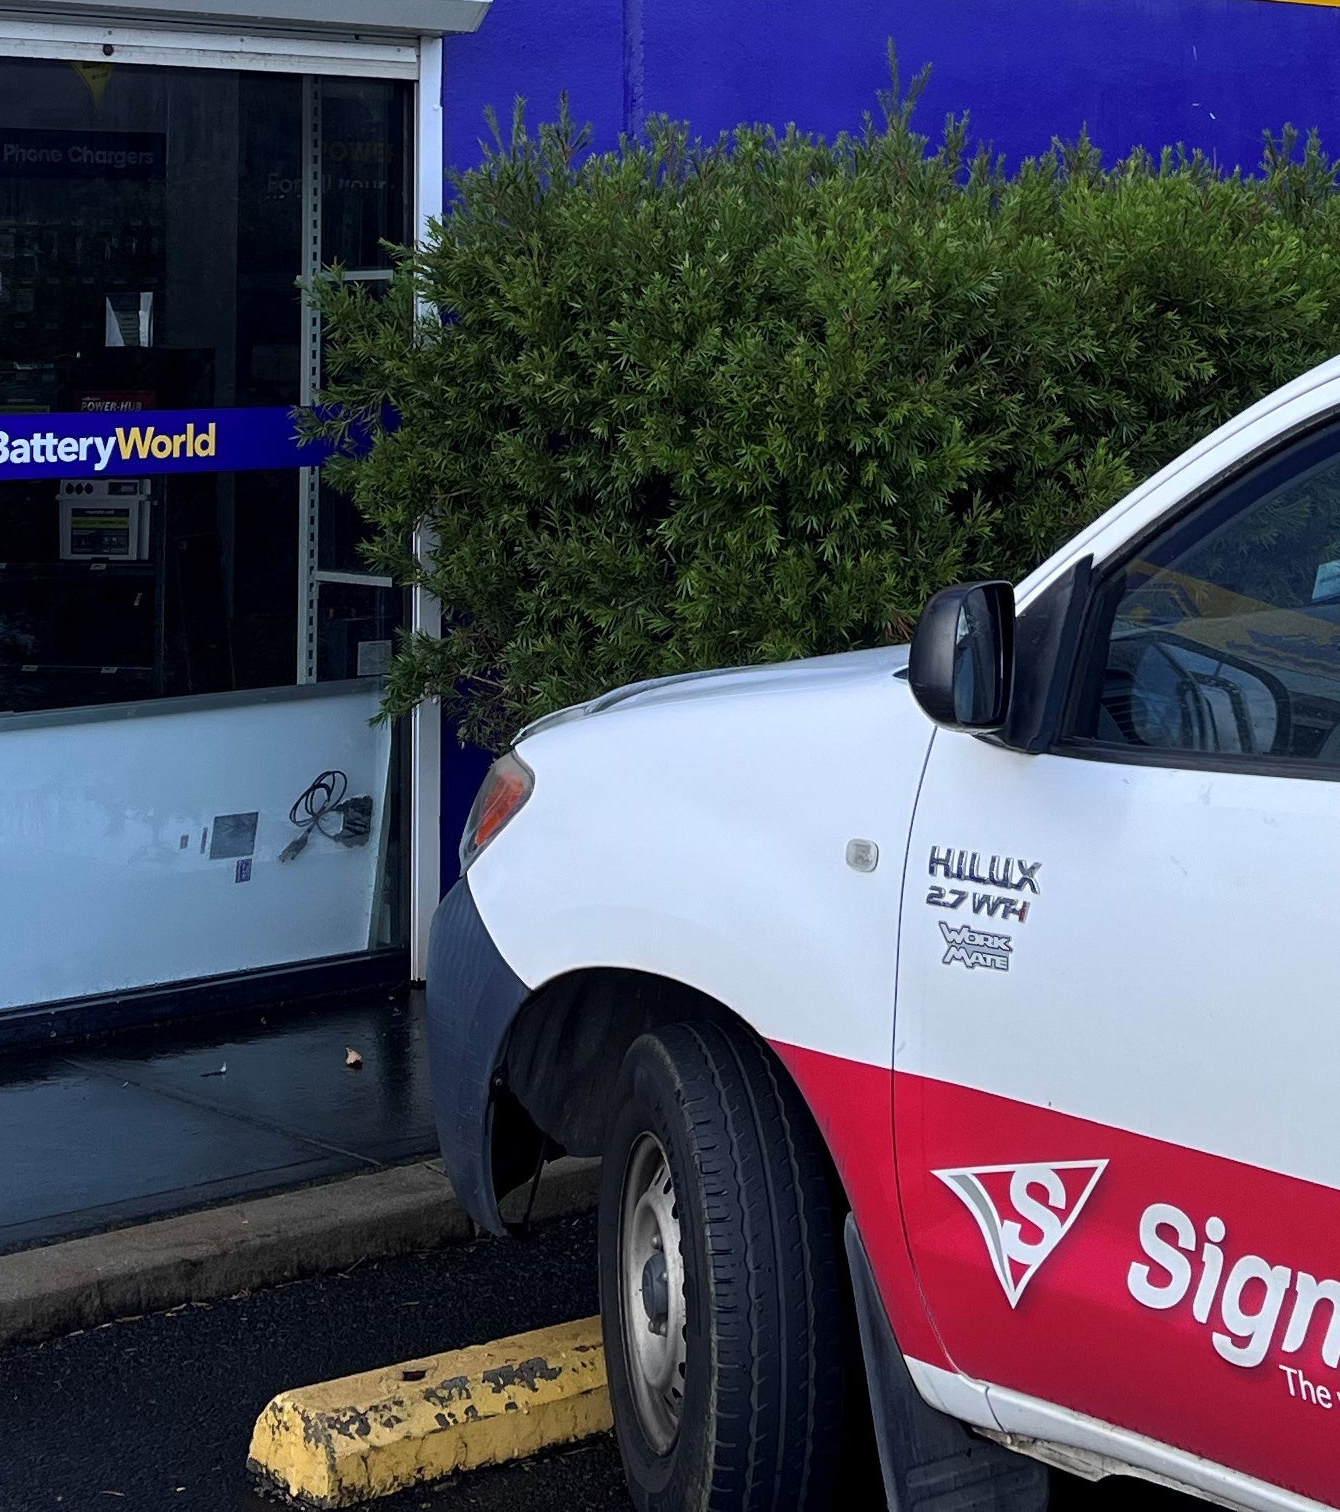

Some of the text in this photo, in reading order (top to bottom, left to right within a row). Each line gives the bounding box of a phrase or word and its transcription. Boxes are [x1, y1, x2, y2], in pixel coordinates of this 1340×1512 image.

[3, 143, 155, 169] Phone Chargers
[927, 845, 1043, 895] HILUX
[938, 920, 1014, 952] WORK
[941, 943, 1010, 971] MATE
[1278, 1364, 1333, 1410] The
